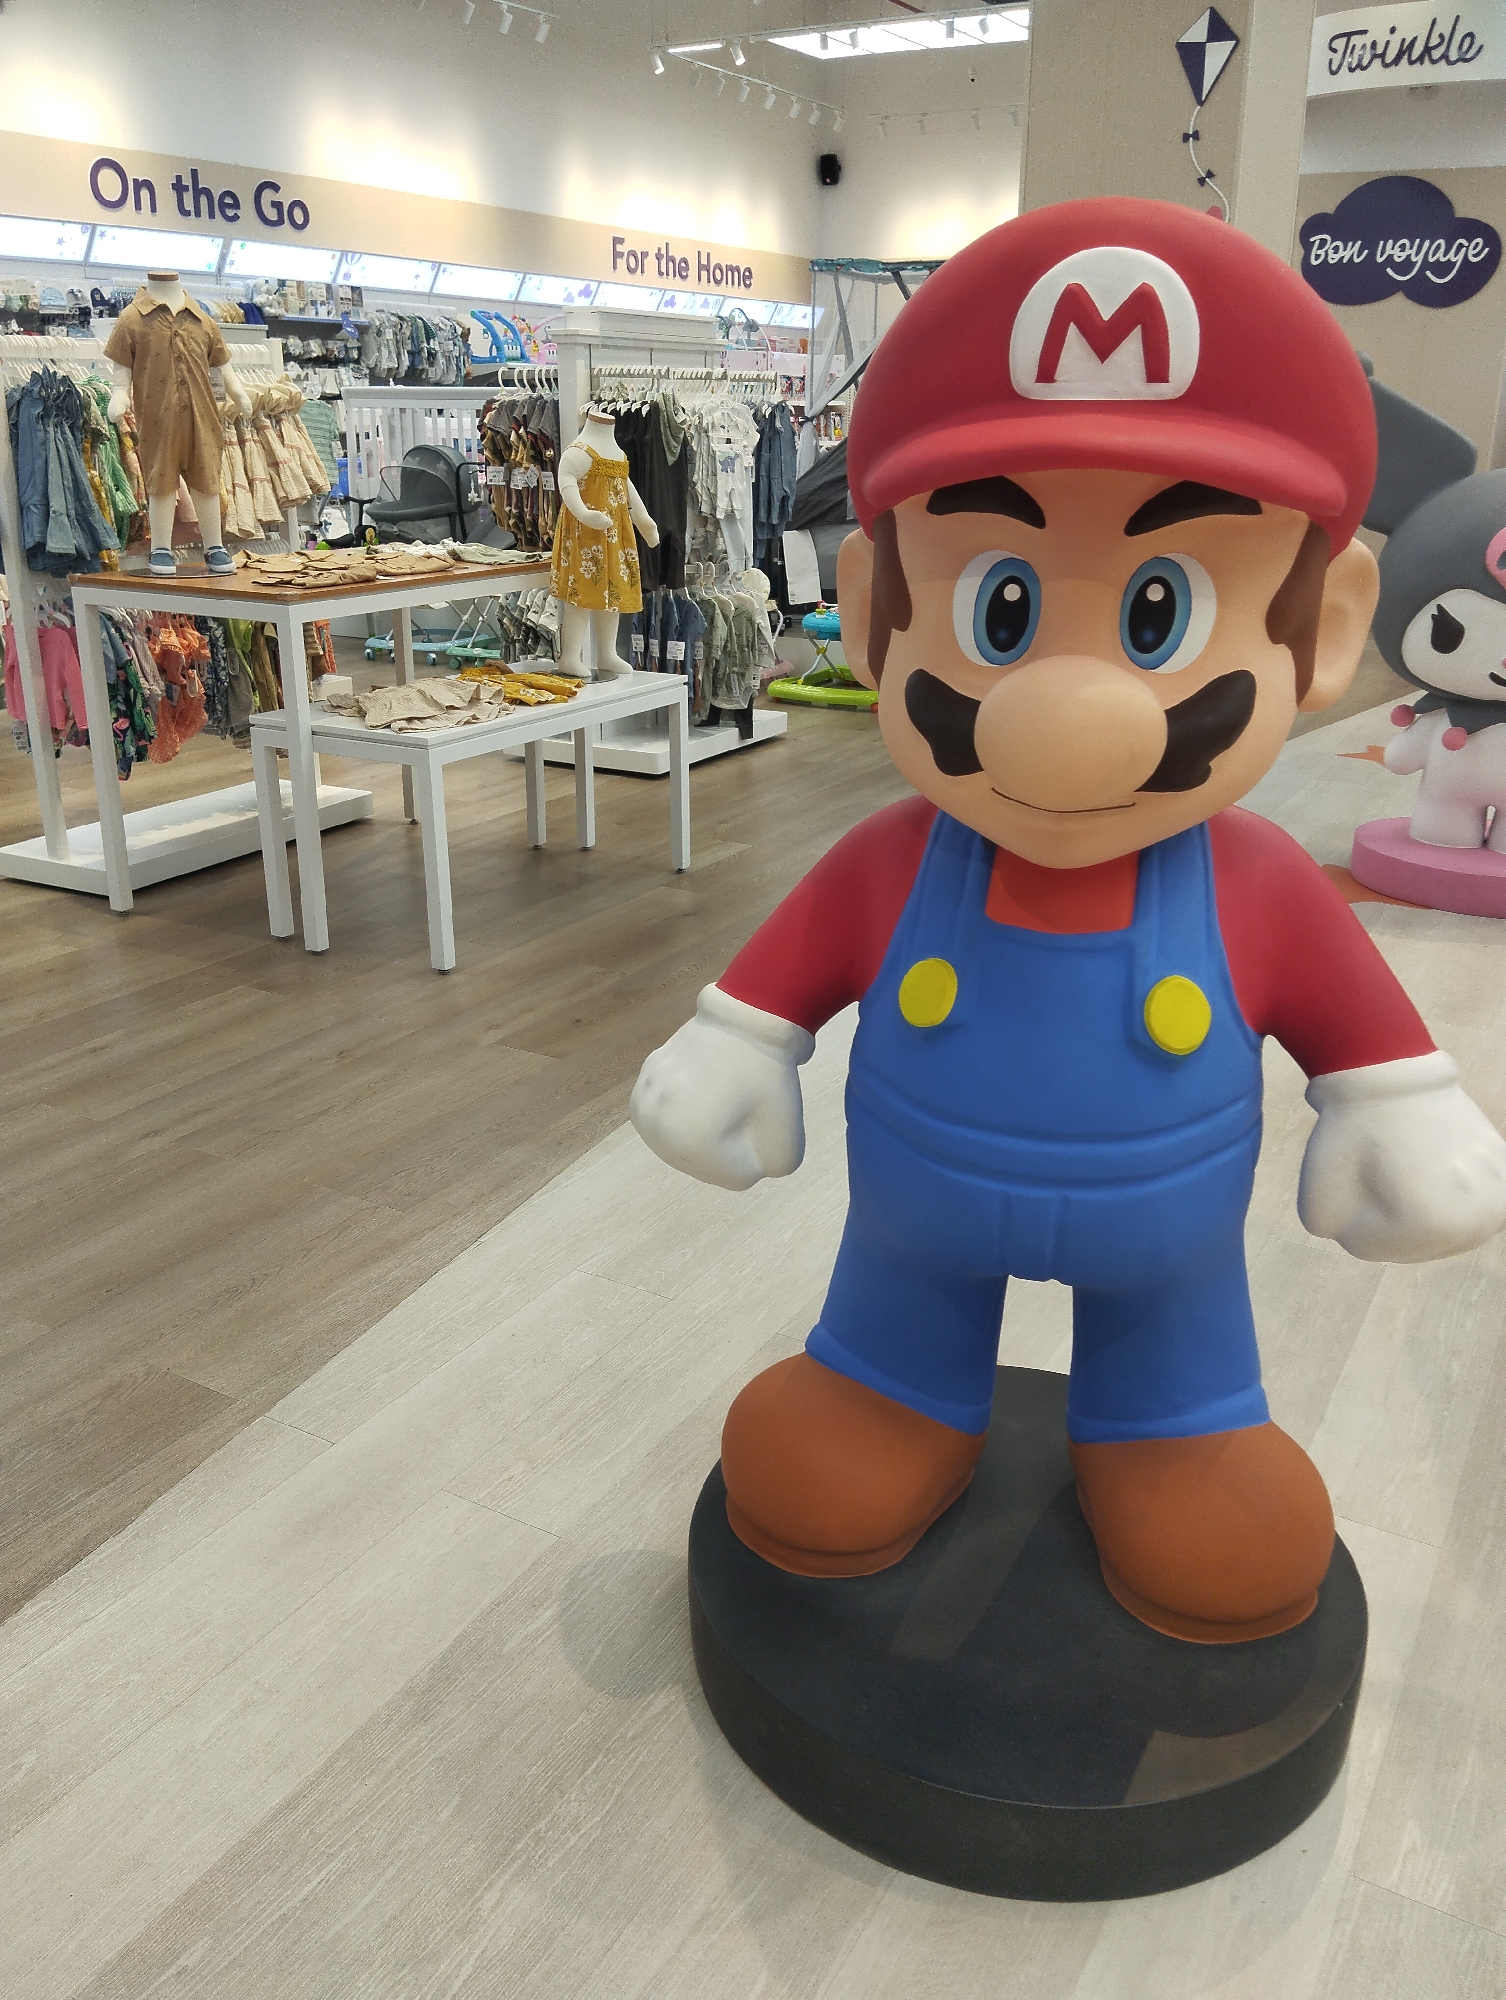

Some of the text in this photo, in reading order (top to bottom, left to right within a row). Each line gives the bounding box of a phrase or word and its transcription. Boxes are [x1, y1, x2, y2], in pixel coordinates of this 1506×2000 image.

[1328, 15, 1484, 76] Twinkle
[89, 157, 310, 231] On the Go
[612, 236, 753, 288] For the Home
[1309, 234, 1489, 284] Bon voyage
[1034, 281, 1171, 383] M
